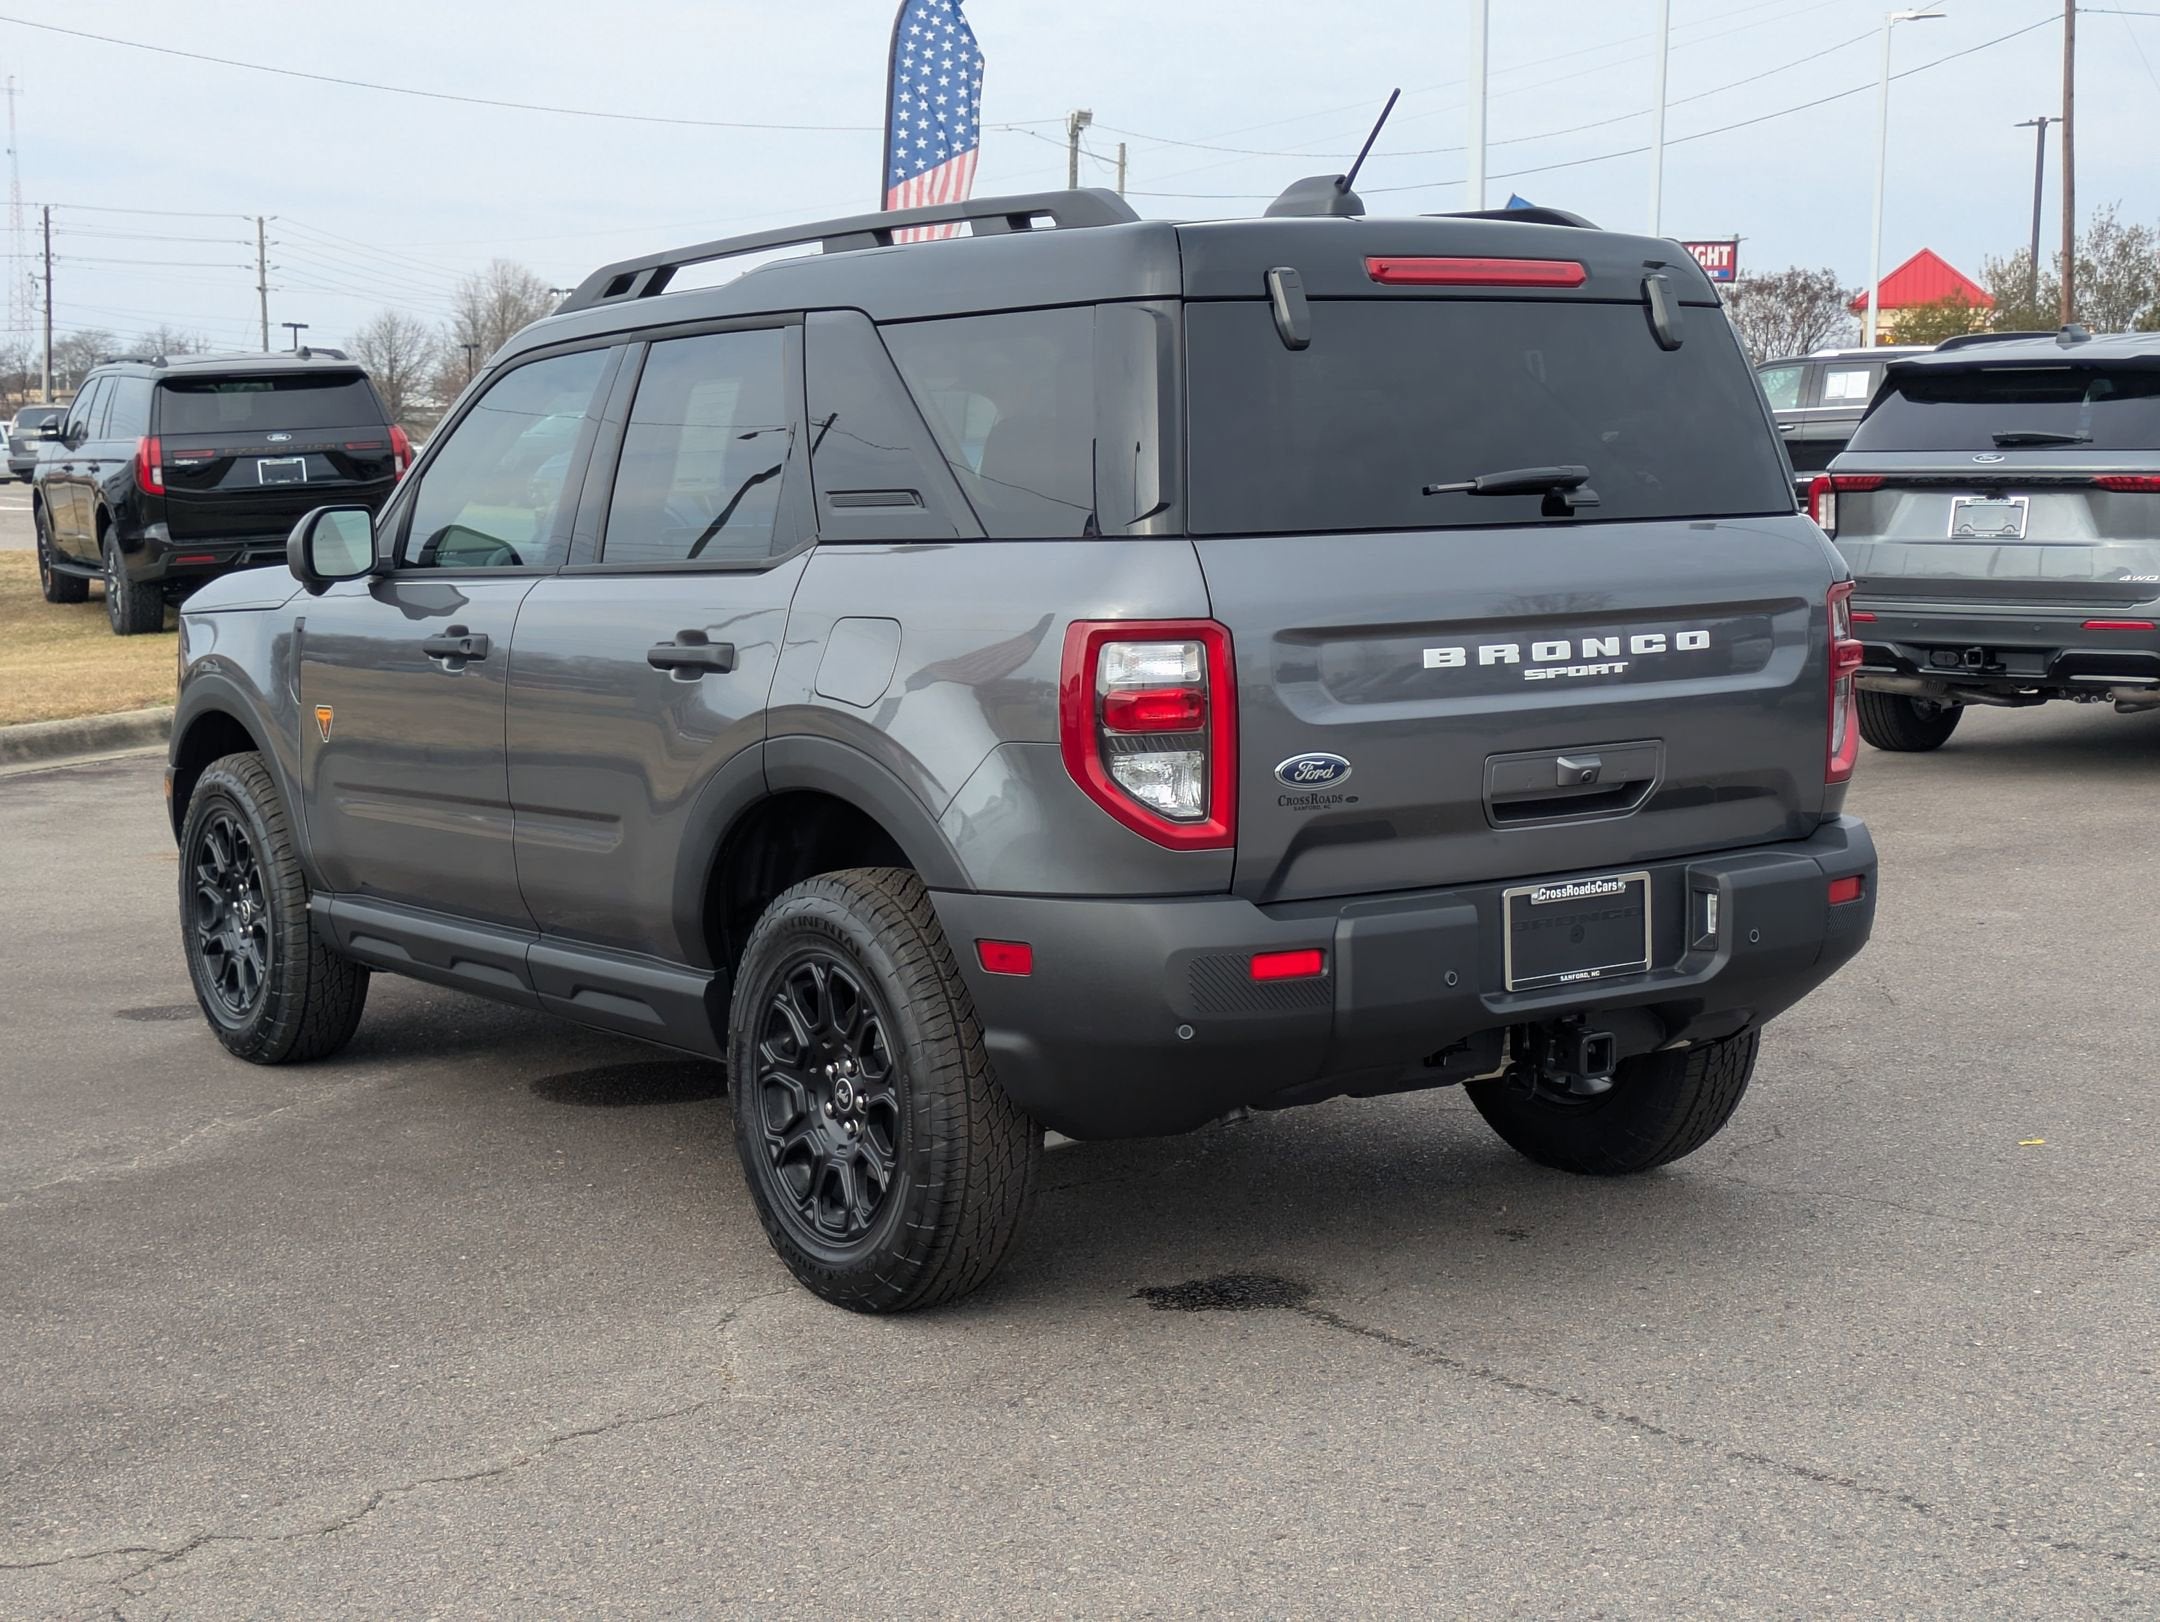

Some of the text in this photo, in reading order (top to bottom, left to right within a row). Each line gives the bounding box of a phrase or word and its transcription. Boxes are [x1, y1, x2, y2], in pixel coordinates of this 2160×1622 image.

[1423, 630, 1711, 669] BRONCO
[1524, 662, 1629, 680] SPORT
[1294, 760, 1336, 781] Ford
[1539, 880, 1617, 900] CrossRoadsCars
